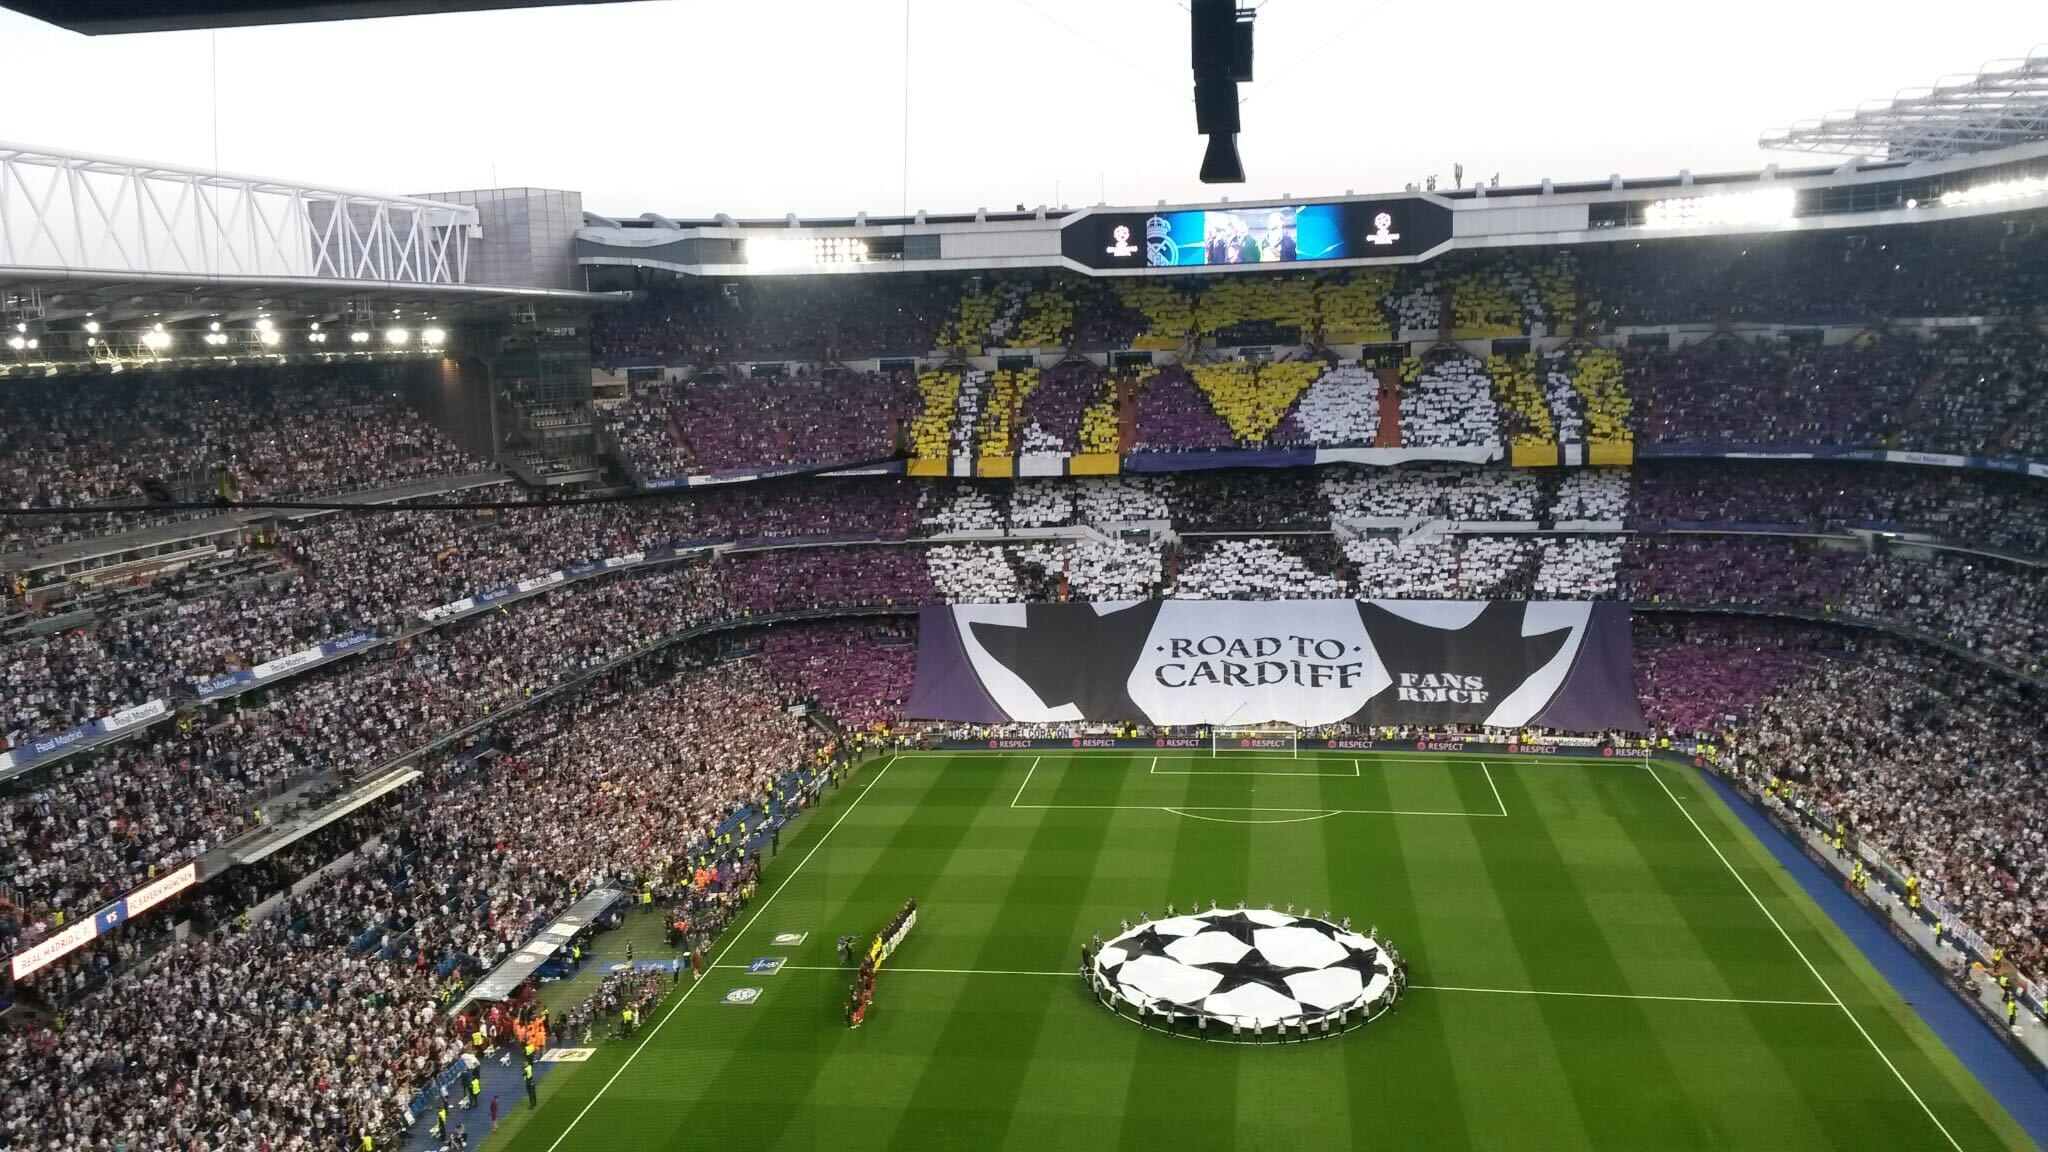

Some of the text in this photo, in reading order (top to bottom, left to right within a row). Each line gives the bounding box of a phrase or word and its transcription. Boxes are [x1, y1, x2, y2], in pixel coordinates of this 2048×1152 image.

[1170, 635, 1345, 660] ROAD TO
[1155, 660, 1363, 688] CARDIFF
[1399, 672, 1484, 690] FANS
[1397, 687, 1489, 704] RMCF
[113, 705, 159, 726] Real Madrid
[1029, 728, 1069, 739] CORAON
[35, 729, 84, 753] Real Madrid
[1000, 740, 1031, 748] RESPECT
[1083, 739, 1115, 748] RESPECT
[1167, 739, 1199, 747] RESPECT
[1252, 739, 1285, 748] RESPECT
[1338, 741, 1373, 749] RESPECT
[1428, 742, 1463, 750] RESPECT
[1520, 745, 1556, 754] RESPECT
[1615, 748, 1652, 757] RESPECT
[44, 935, 74, 956] MADRID
